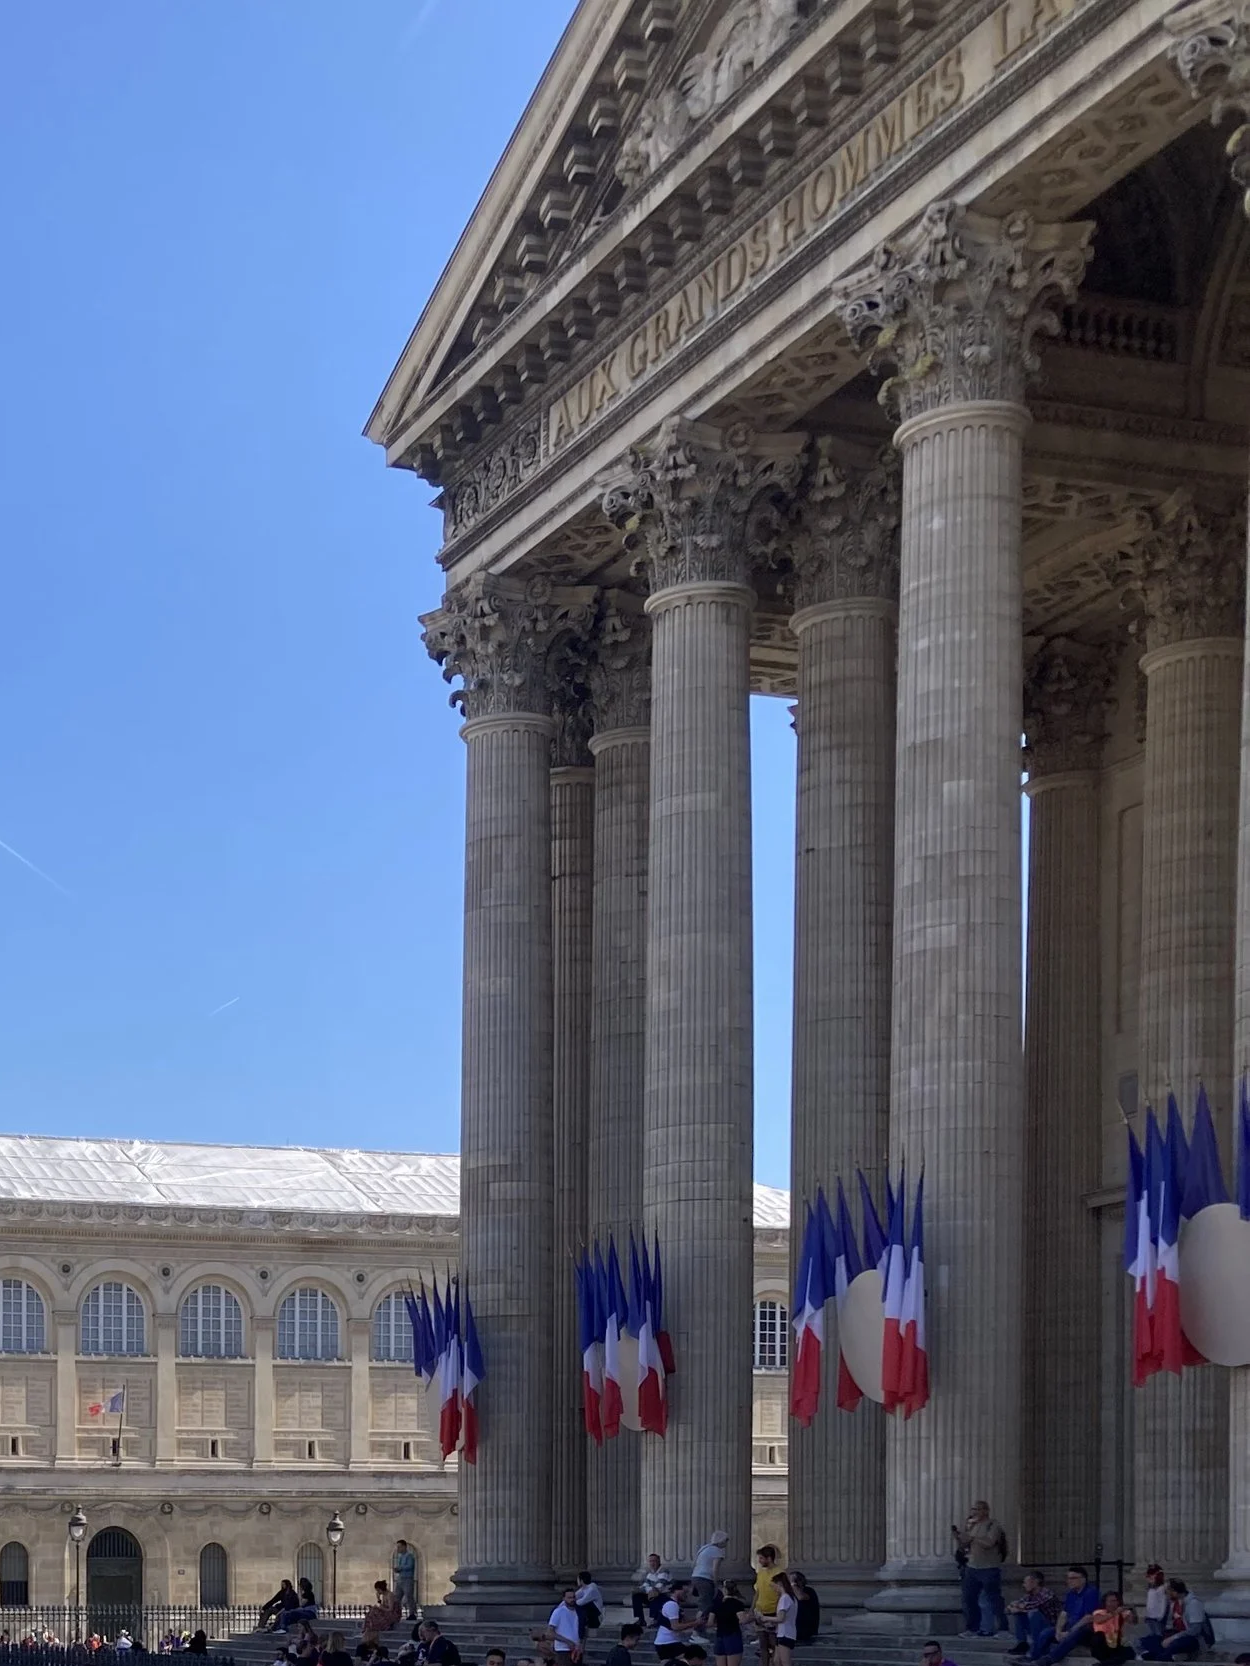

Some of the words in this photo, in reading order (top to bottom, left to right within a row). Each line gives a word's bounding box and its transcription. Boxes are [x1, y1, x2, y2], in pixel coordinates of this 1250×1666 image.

[553, 352, 618, 447] AUX
[625, 218, 770, 380] GRANDS
[776, 47, 965, 252] HOMMES
